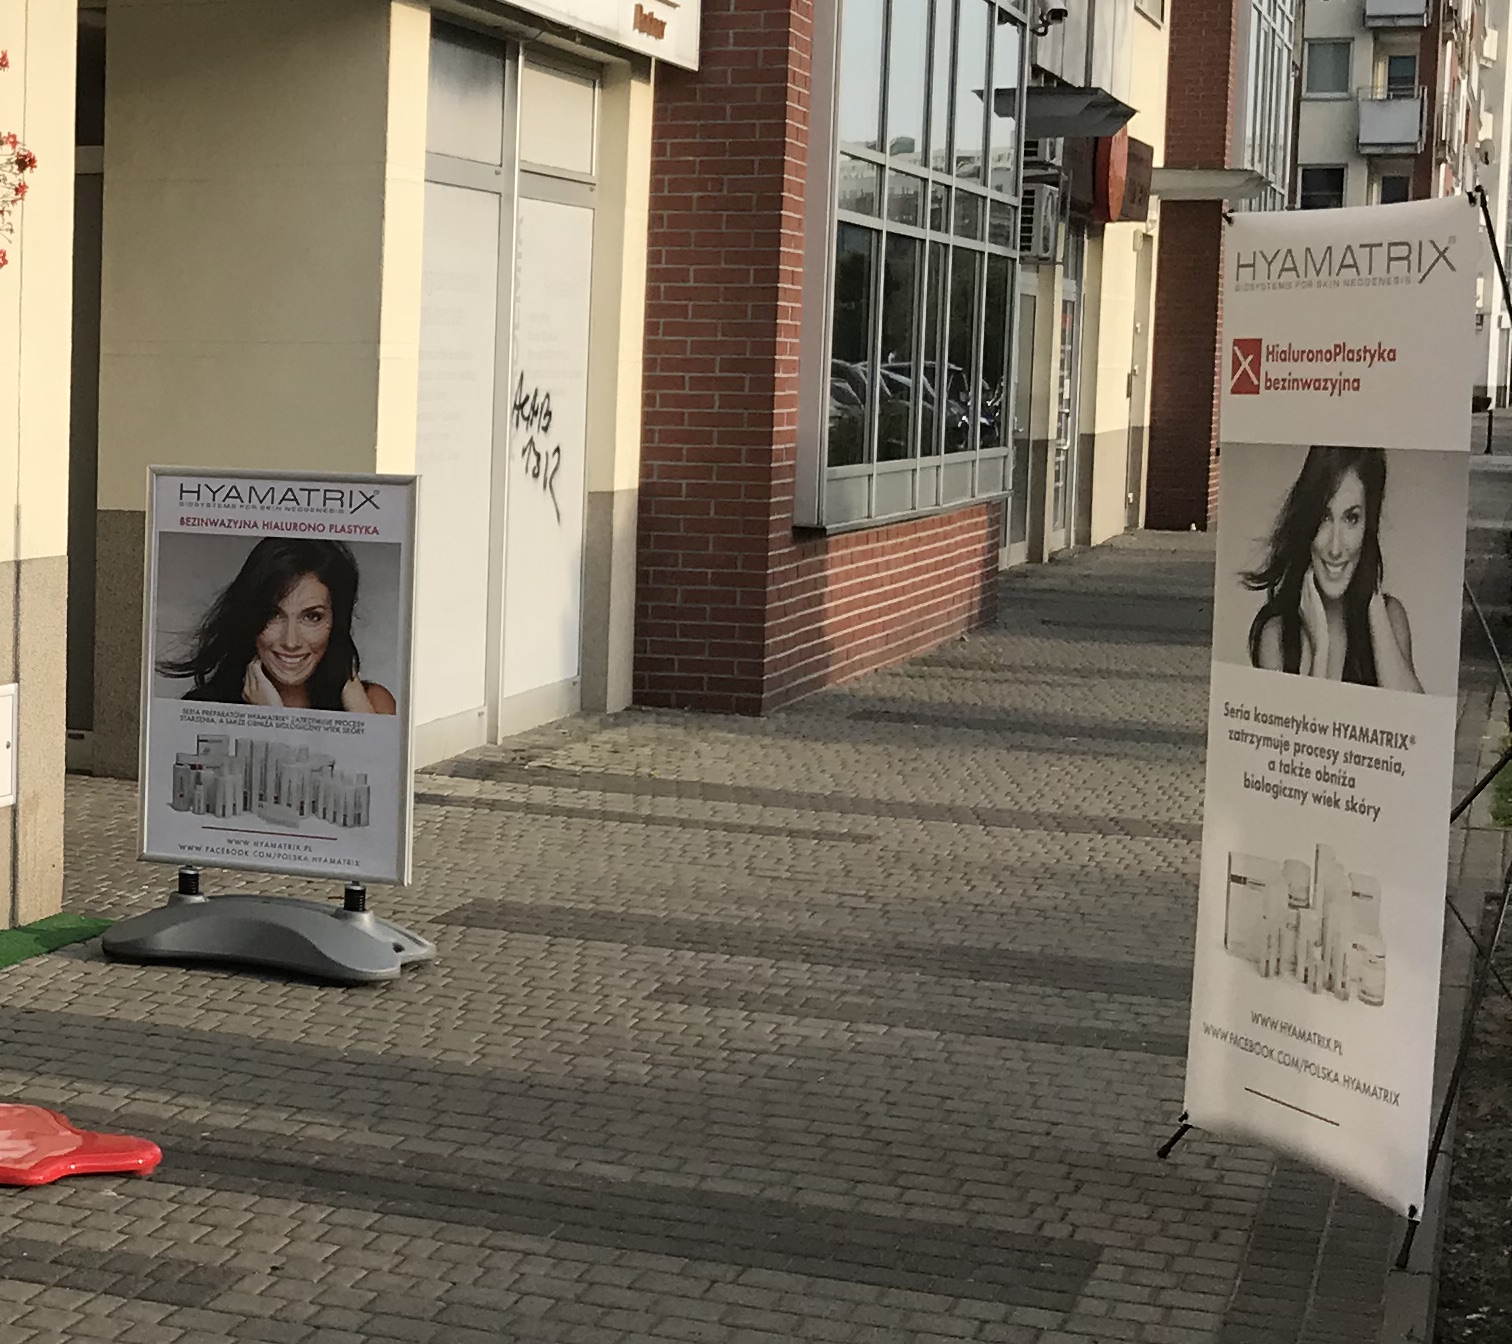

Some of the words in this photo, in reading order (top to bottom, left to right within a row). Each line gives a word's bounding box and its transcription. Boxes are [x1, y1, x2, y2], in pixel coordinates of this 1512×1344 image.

[1236, 239, 1456, 284] HYAMATRIX
[1265, 341, 1397, 368] HialuronoPlastyka
[1264, 370, 1361, 396] bezinwazyjna
[179, 483, 380, 514] HYAMATRIX
[179, 516, 259, 529] BEZINWAZYJNA
[262, 520, 326, 533] HIALURONO
[328, 522, 380, 535] PLASTYKA
[1223, 702, 1251, 721] Seria
[1254, 706, 1330, 735] kosmetyków
[1332, 721, 1410, 751] HYAMATRIX
[1228, 728, 1290, 756] zatrzymuje
[1293, 742, 1340, 766] procesy
[1342, 749, 1406, 777] starzenia,
[1268, 759, 1276, 771] a
[1279, 758, 1312, 780] także
[1315, 765, 1356, 789] obniża
[1243, 771, 1309, 806] biologiczny
[1311, 789, 1341, 810] wiek
[1344, 794, 1382, 823] skóry
